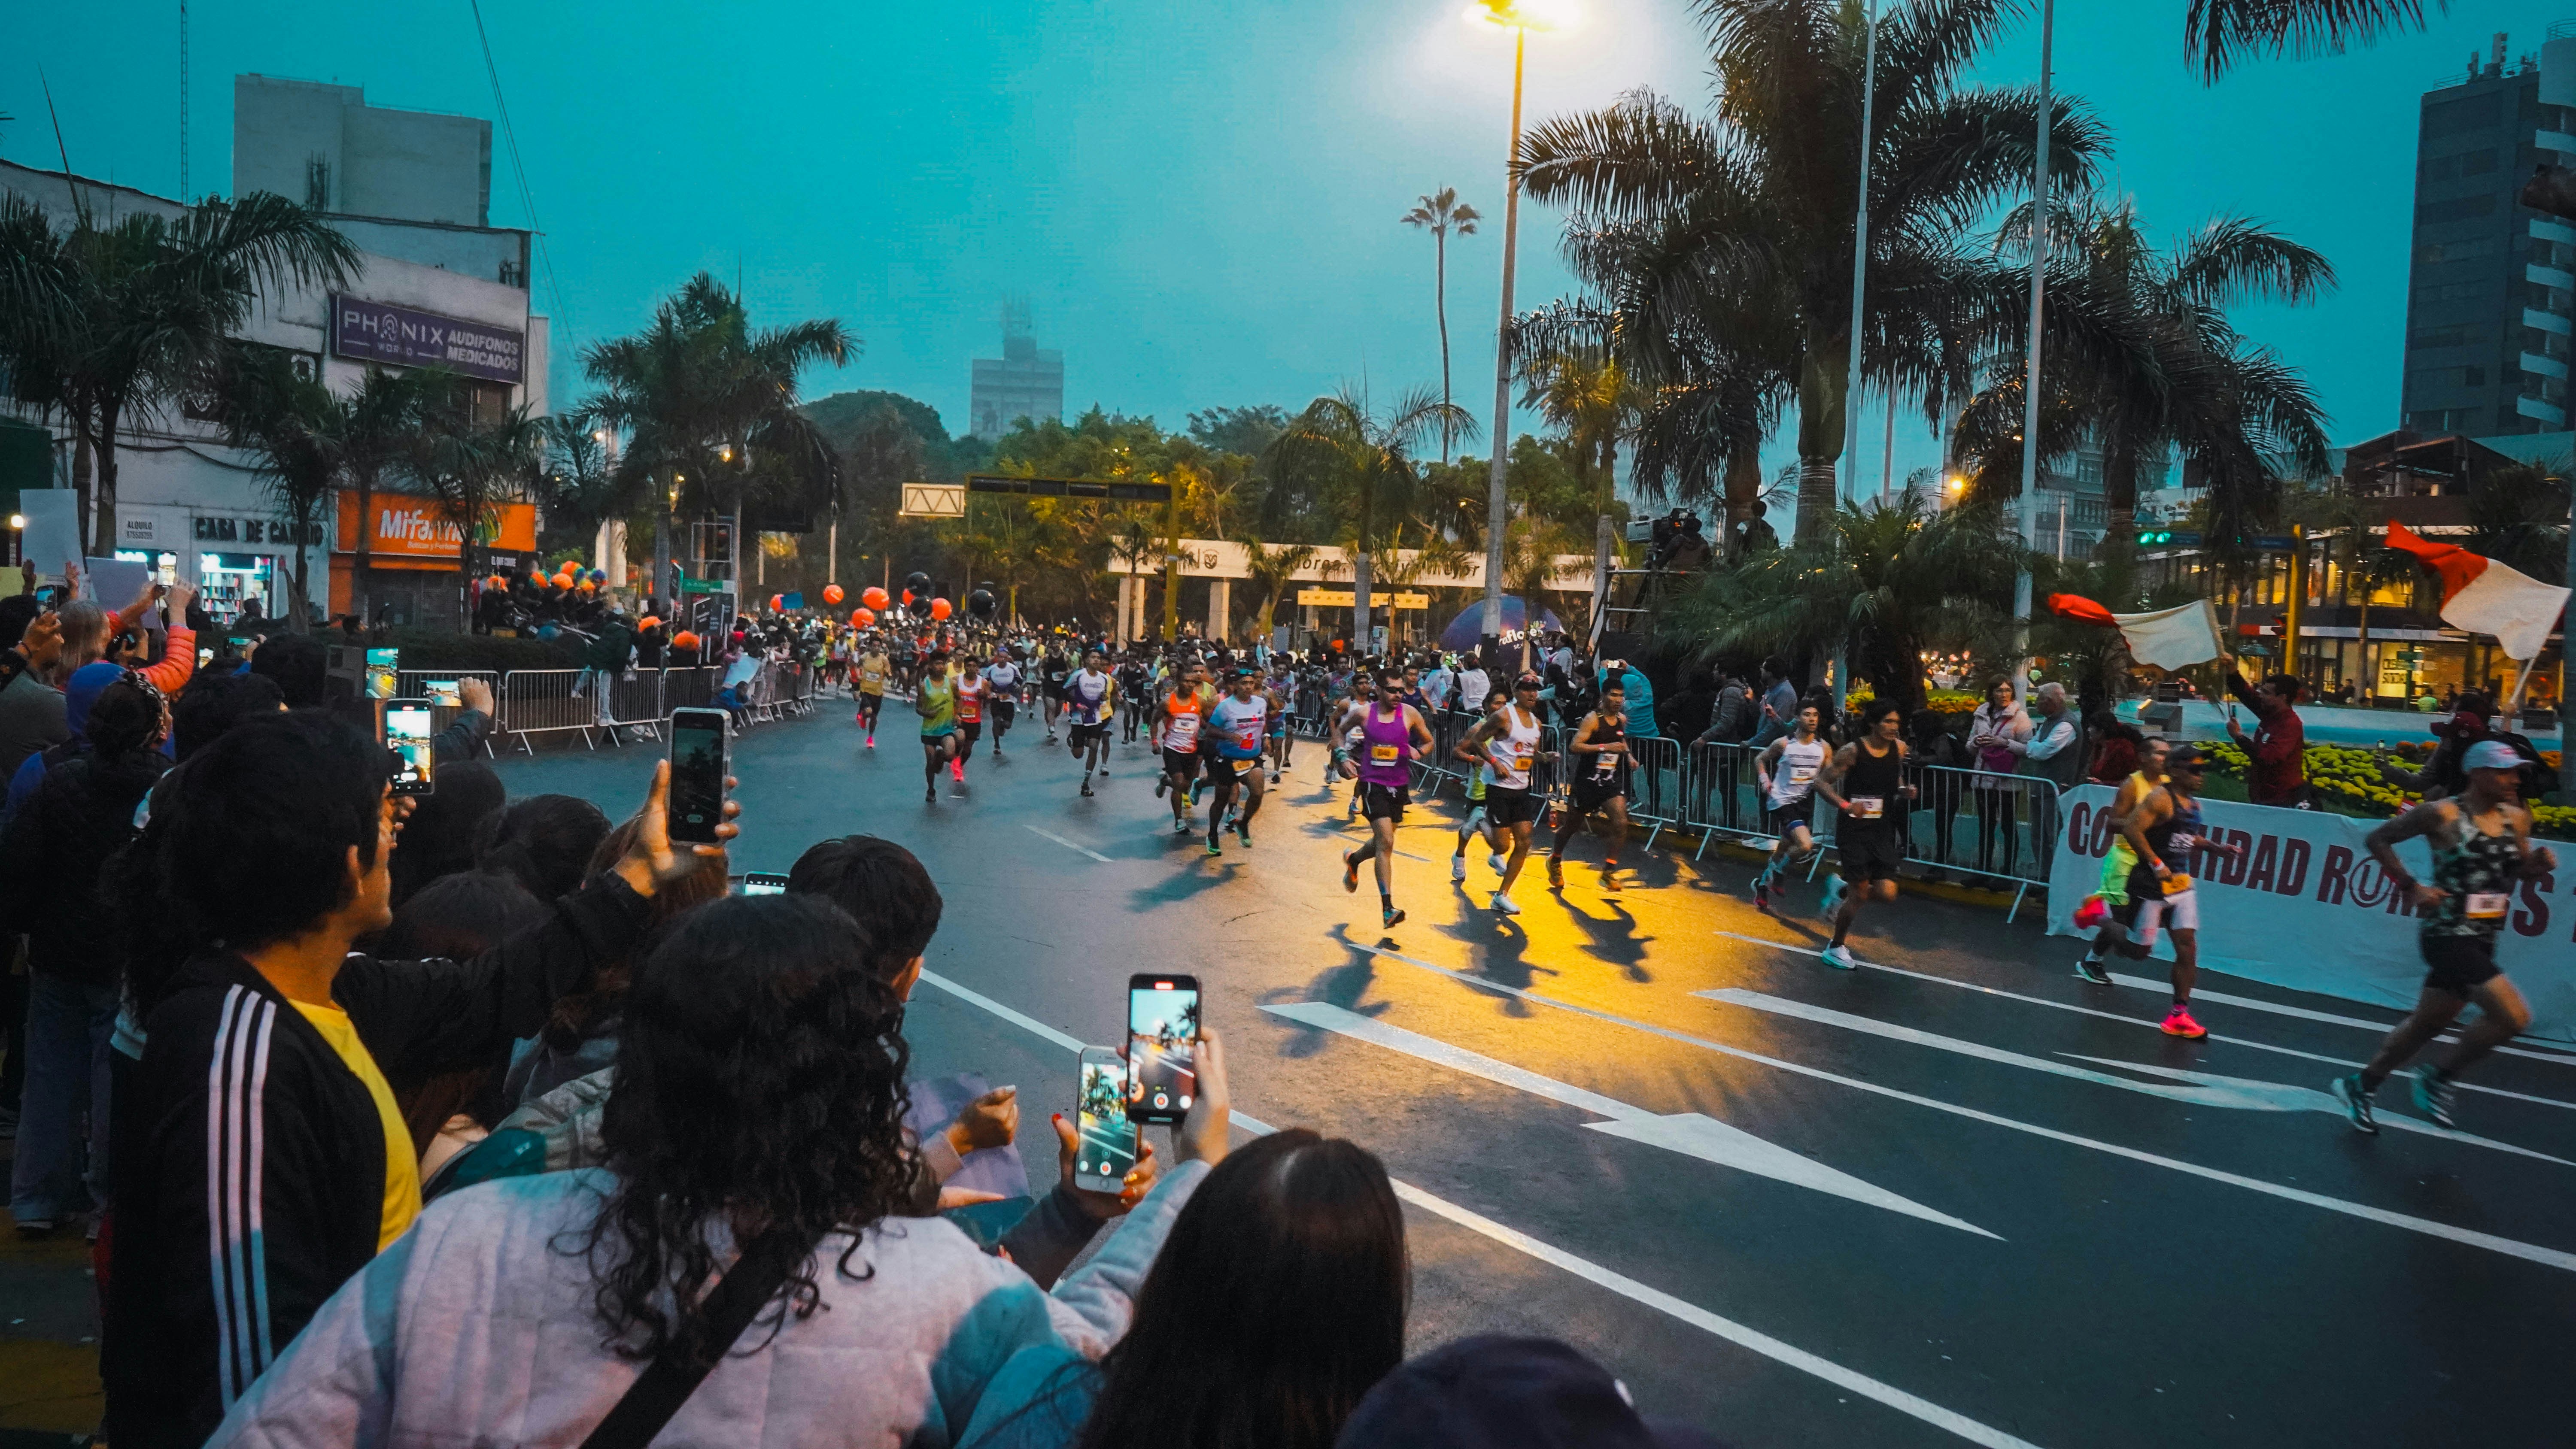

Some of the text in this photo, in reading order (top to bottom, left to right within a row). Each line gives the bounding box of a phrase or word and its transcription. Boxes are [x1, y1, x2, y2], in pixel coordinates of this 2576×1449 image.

[447, 330, 518, 355] AUDIFONOS
[447, 346, 518, 371] MEDICADOS
[196, 518, 323, 547] CASA DE CAMIO
